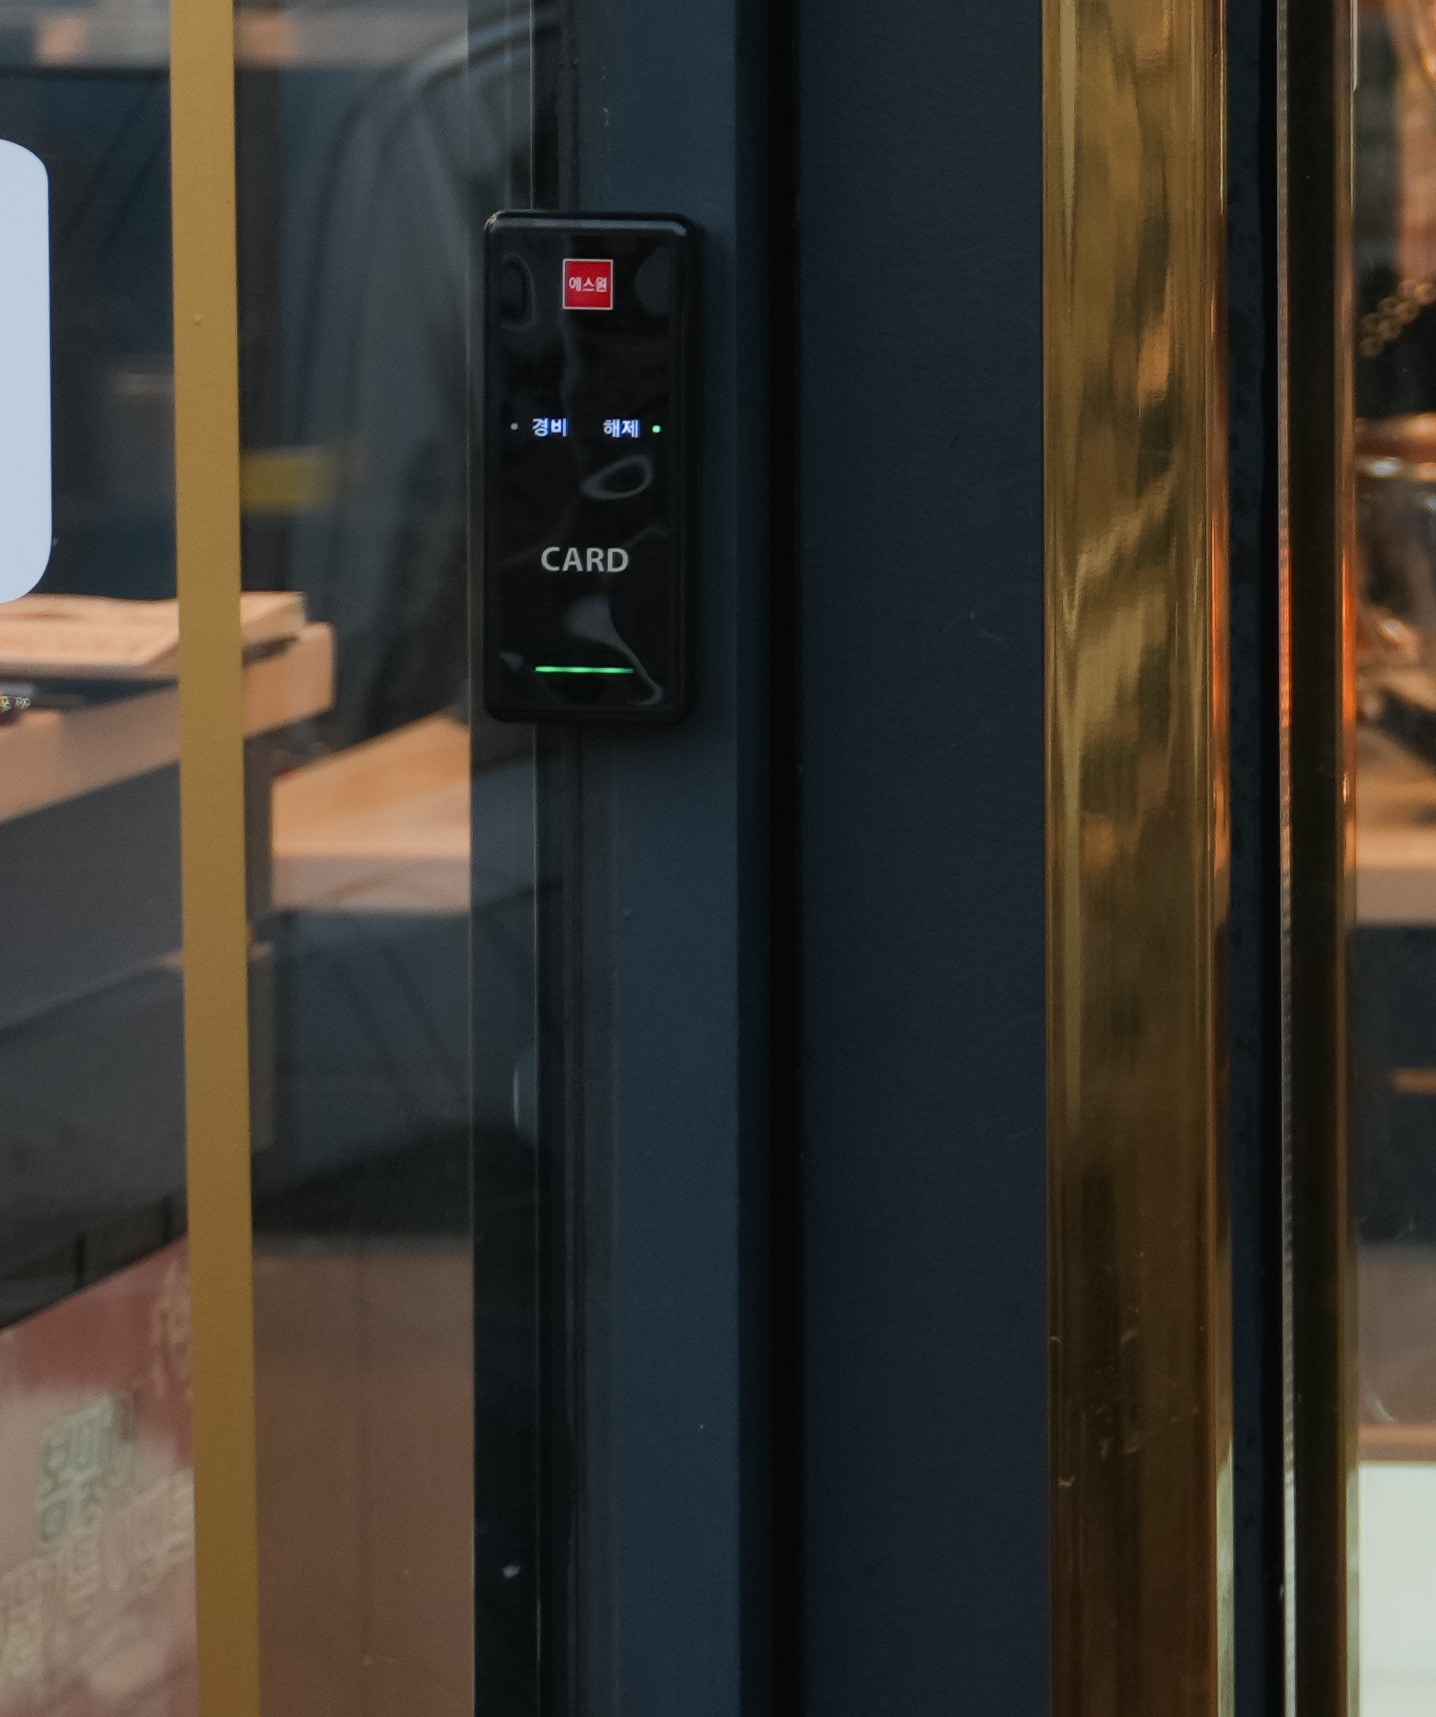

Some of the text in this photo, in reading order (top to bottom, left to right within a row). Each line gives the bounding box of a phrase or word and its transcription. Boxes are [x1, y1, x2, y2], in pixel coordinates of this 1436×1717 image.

[568, 275, 608, 293] 에스원
[531, 416, 569, 438] 경비
[602, 418, 641, 439] 해제
[539, 545, 630, 574] CARD
